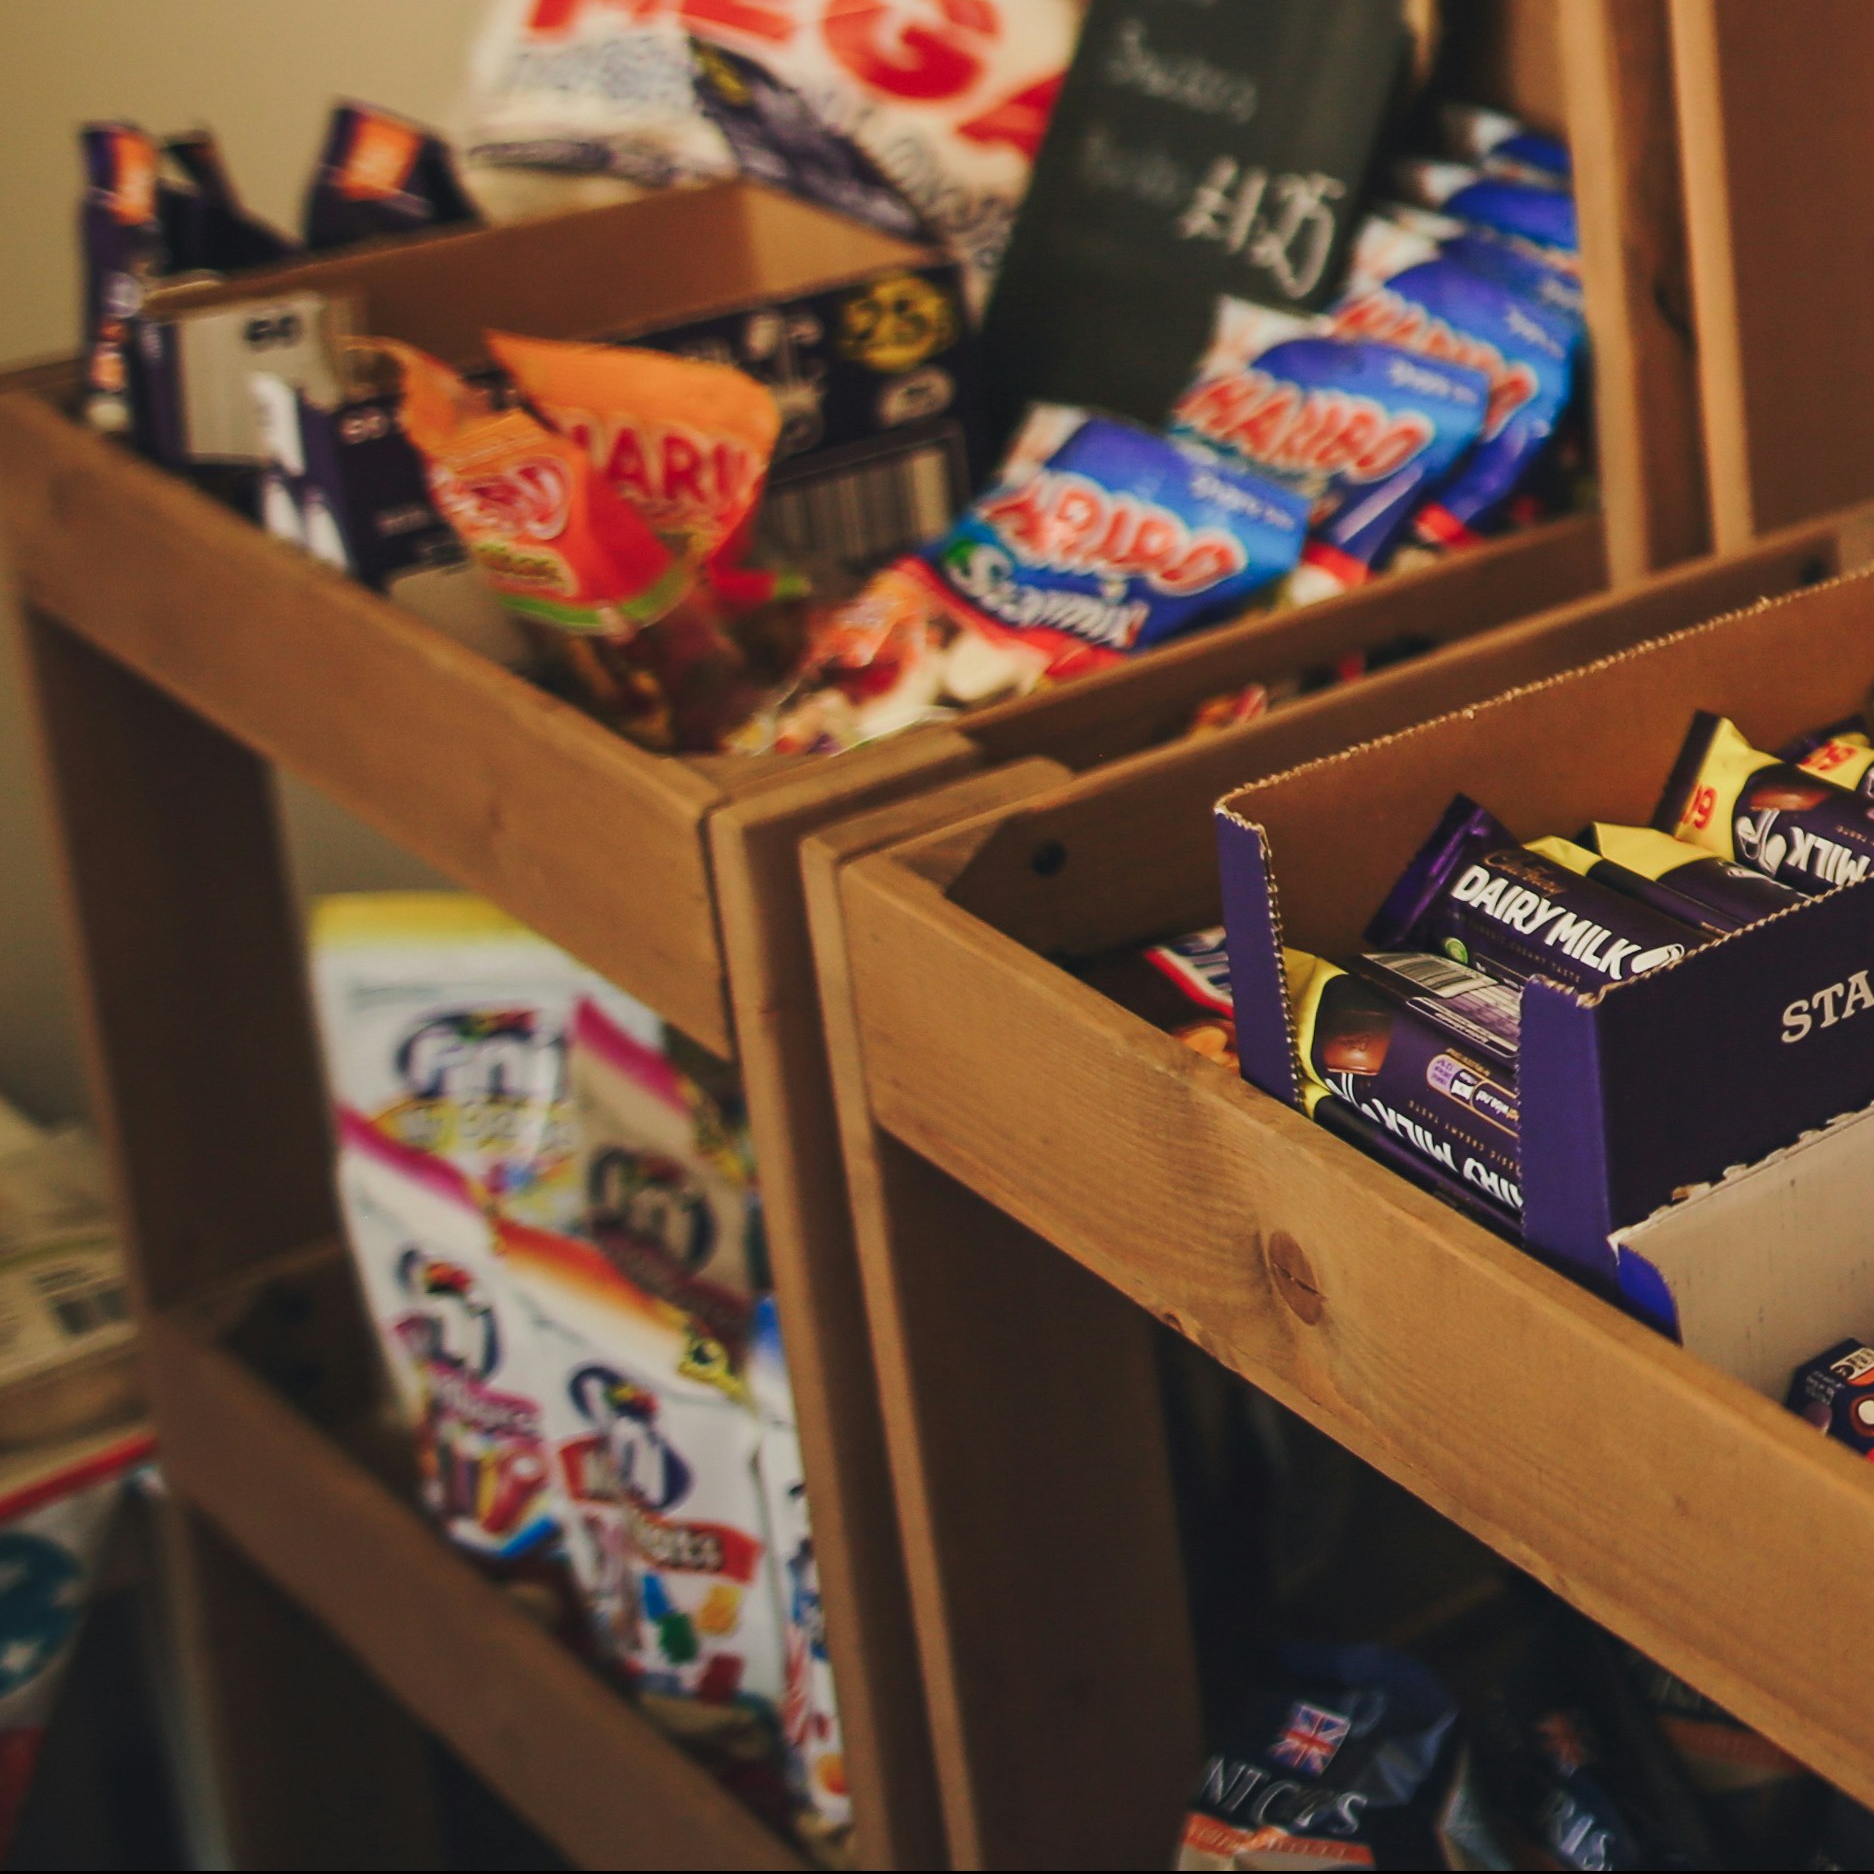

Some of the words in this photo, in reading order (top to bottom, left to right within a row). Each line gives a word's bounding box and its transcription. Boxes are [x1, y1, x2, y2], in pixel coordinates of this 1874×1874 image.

[978, 478, 1240, 586] ARIBO
[1451, 865, 1566, 935] DAIRY
[1544, 911, 1642, 980] MILK
